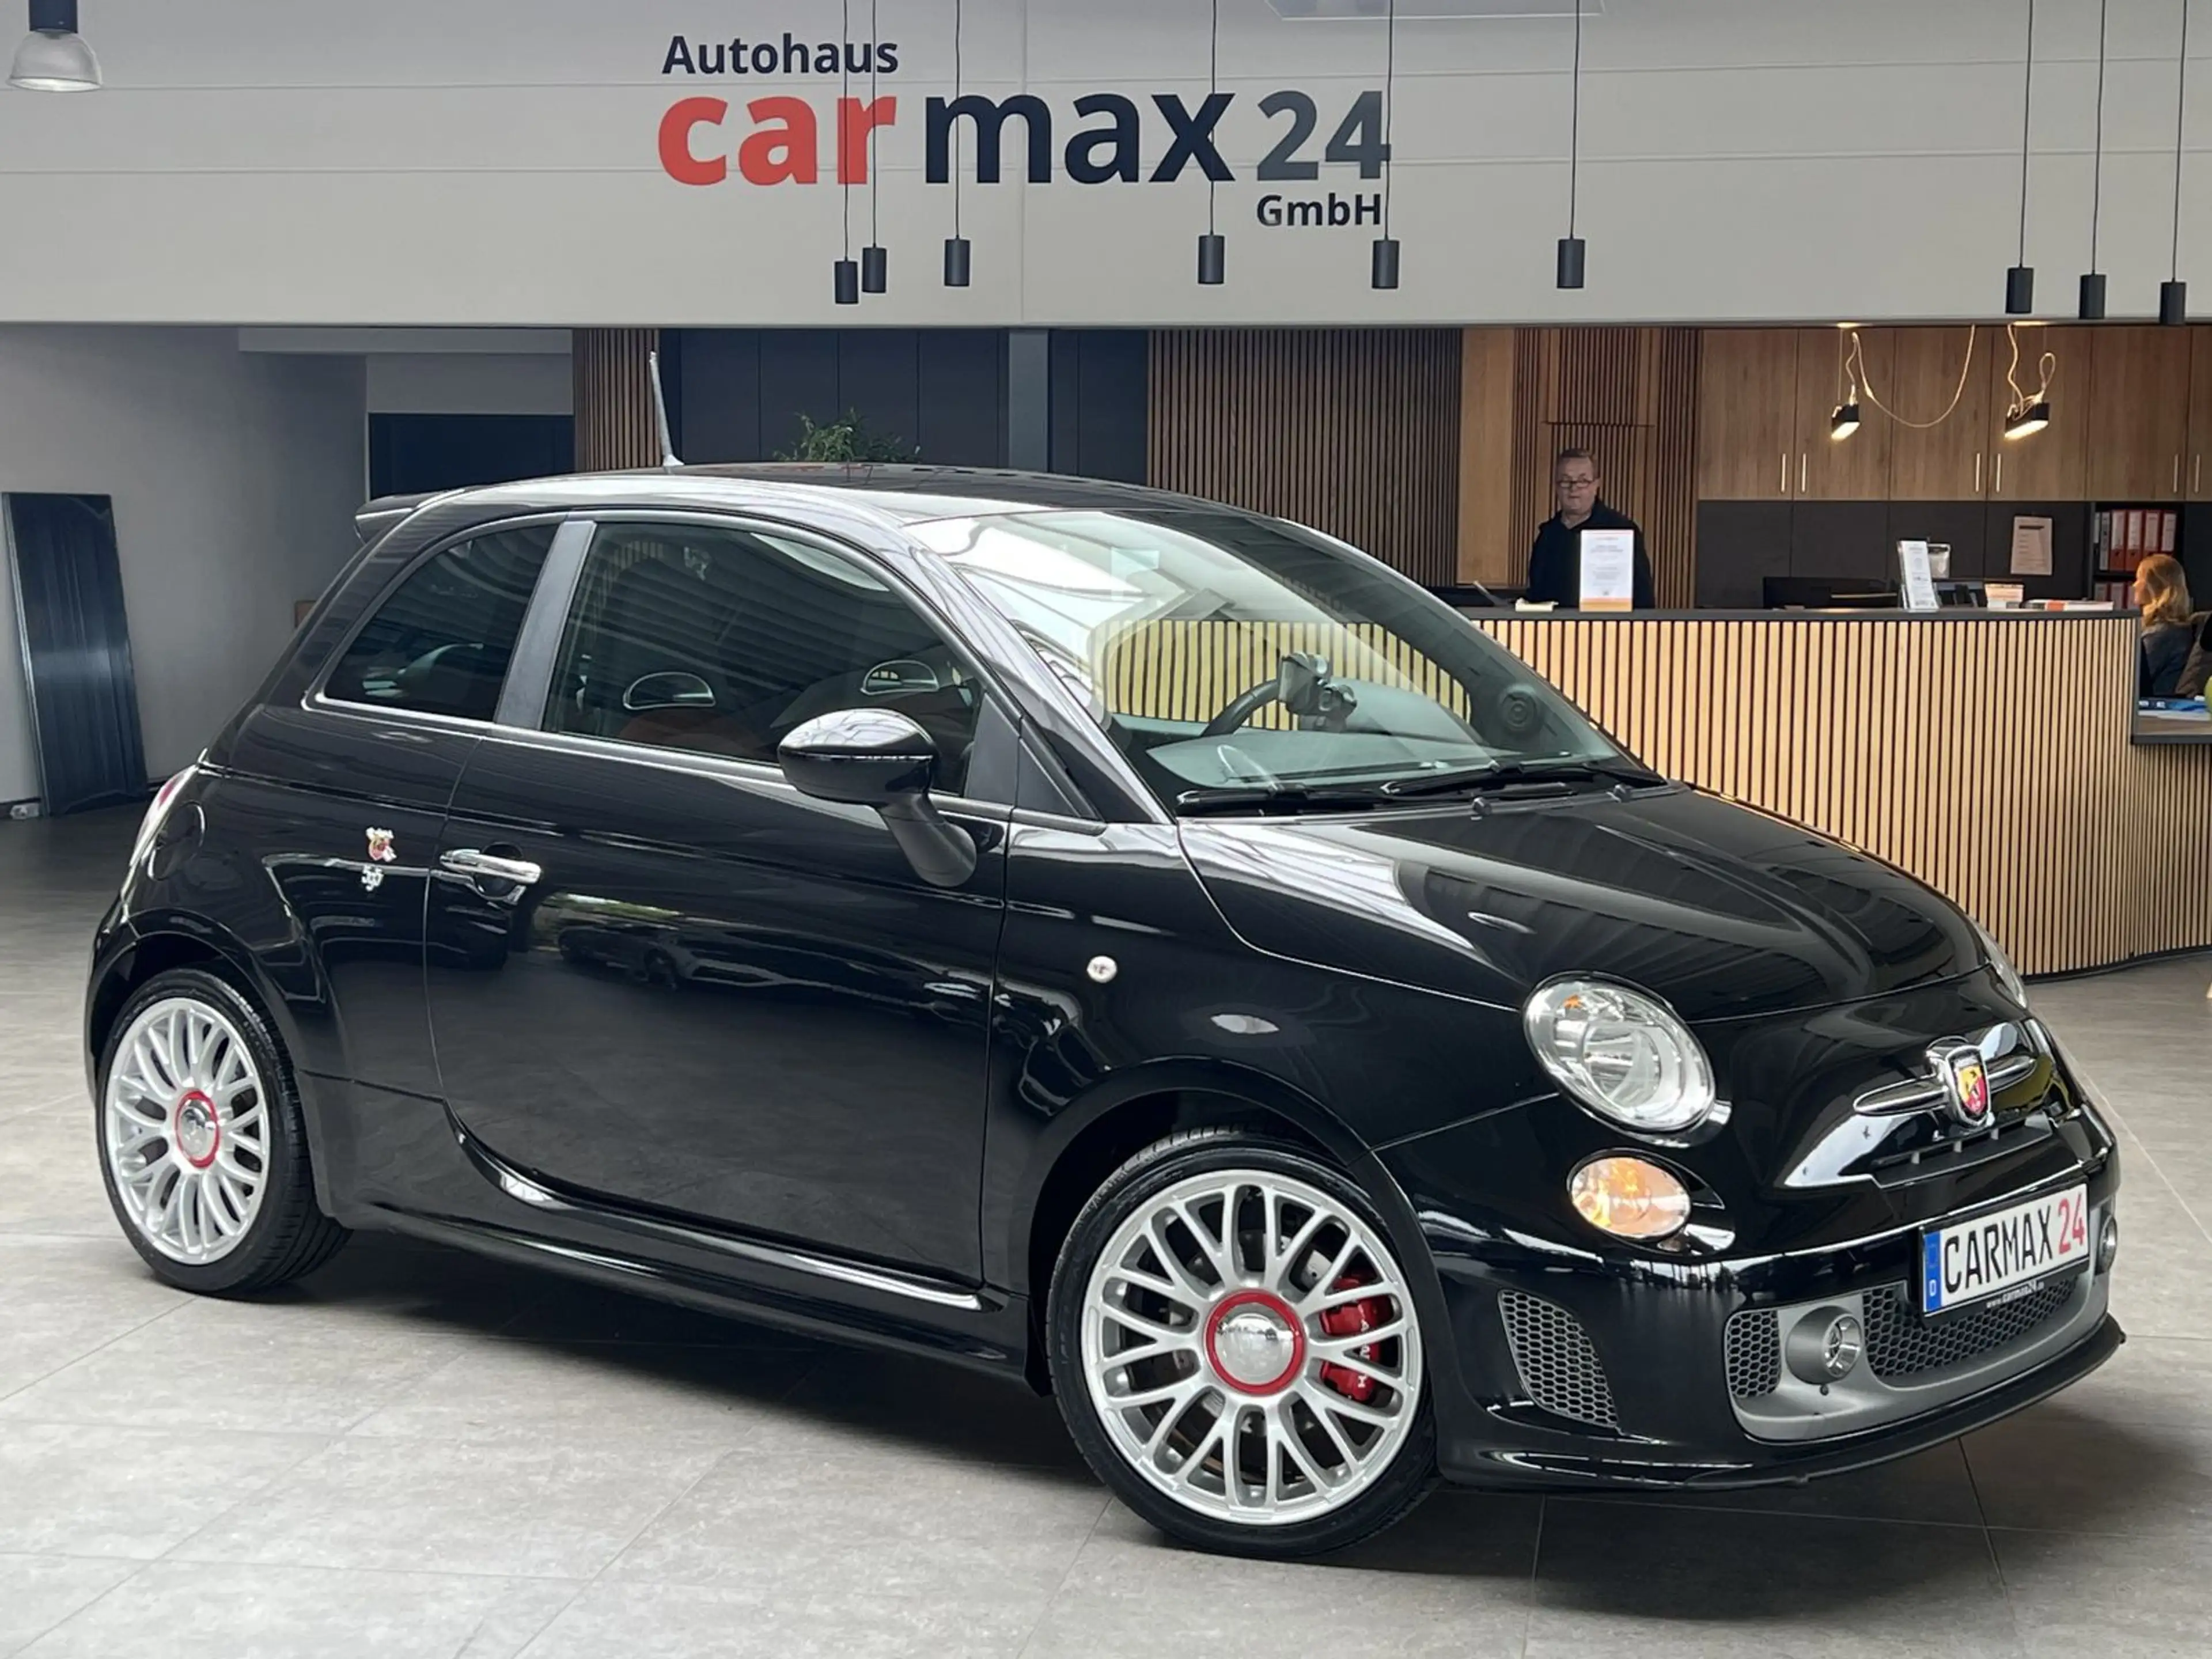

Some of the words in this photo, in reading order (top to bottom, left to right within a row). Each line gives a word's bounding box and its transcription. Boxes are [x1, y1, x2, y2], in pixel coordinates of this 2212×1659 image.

[662, 33, 899, 75] Autohaus
[1256, 90, 1392, 181] 24
[1256, 192, 1382, 226] GmbH
